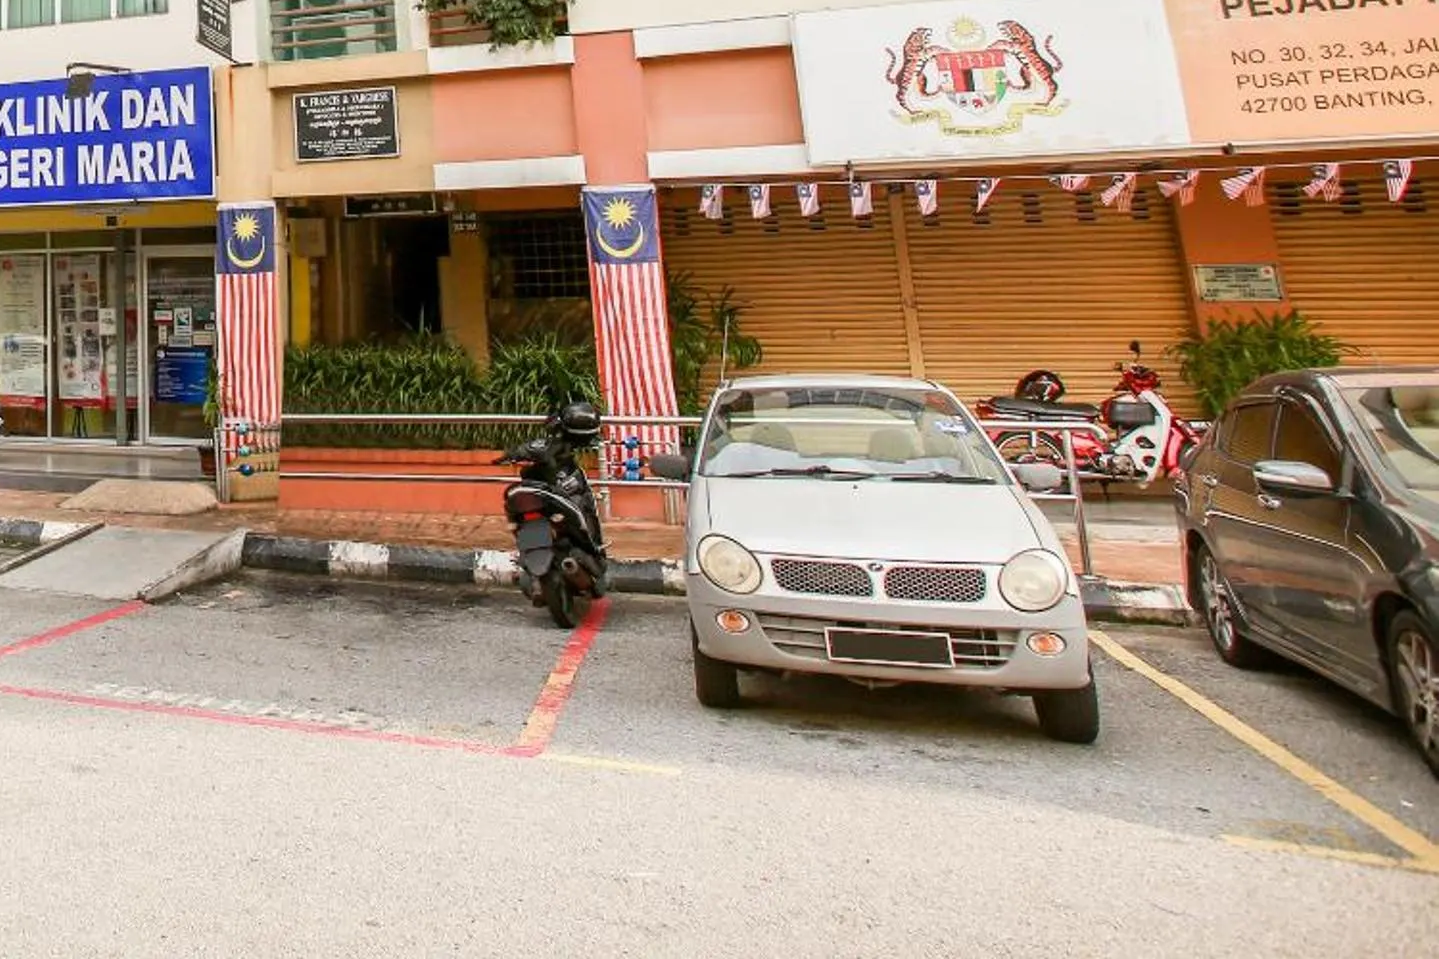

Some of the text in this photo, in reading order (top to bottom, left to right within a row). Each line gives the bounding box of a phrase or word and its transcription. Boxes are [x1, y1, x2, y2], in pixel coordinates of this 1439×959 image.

[1236, 62, 1439, 89] PUSAT PERDAGA
[121, 84, 196, 129] DAN
[1240, 96, 1307, 113] 42700
[77, 139, 195, 186] MARIA
